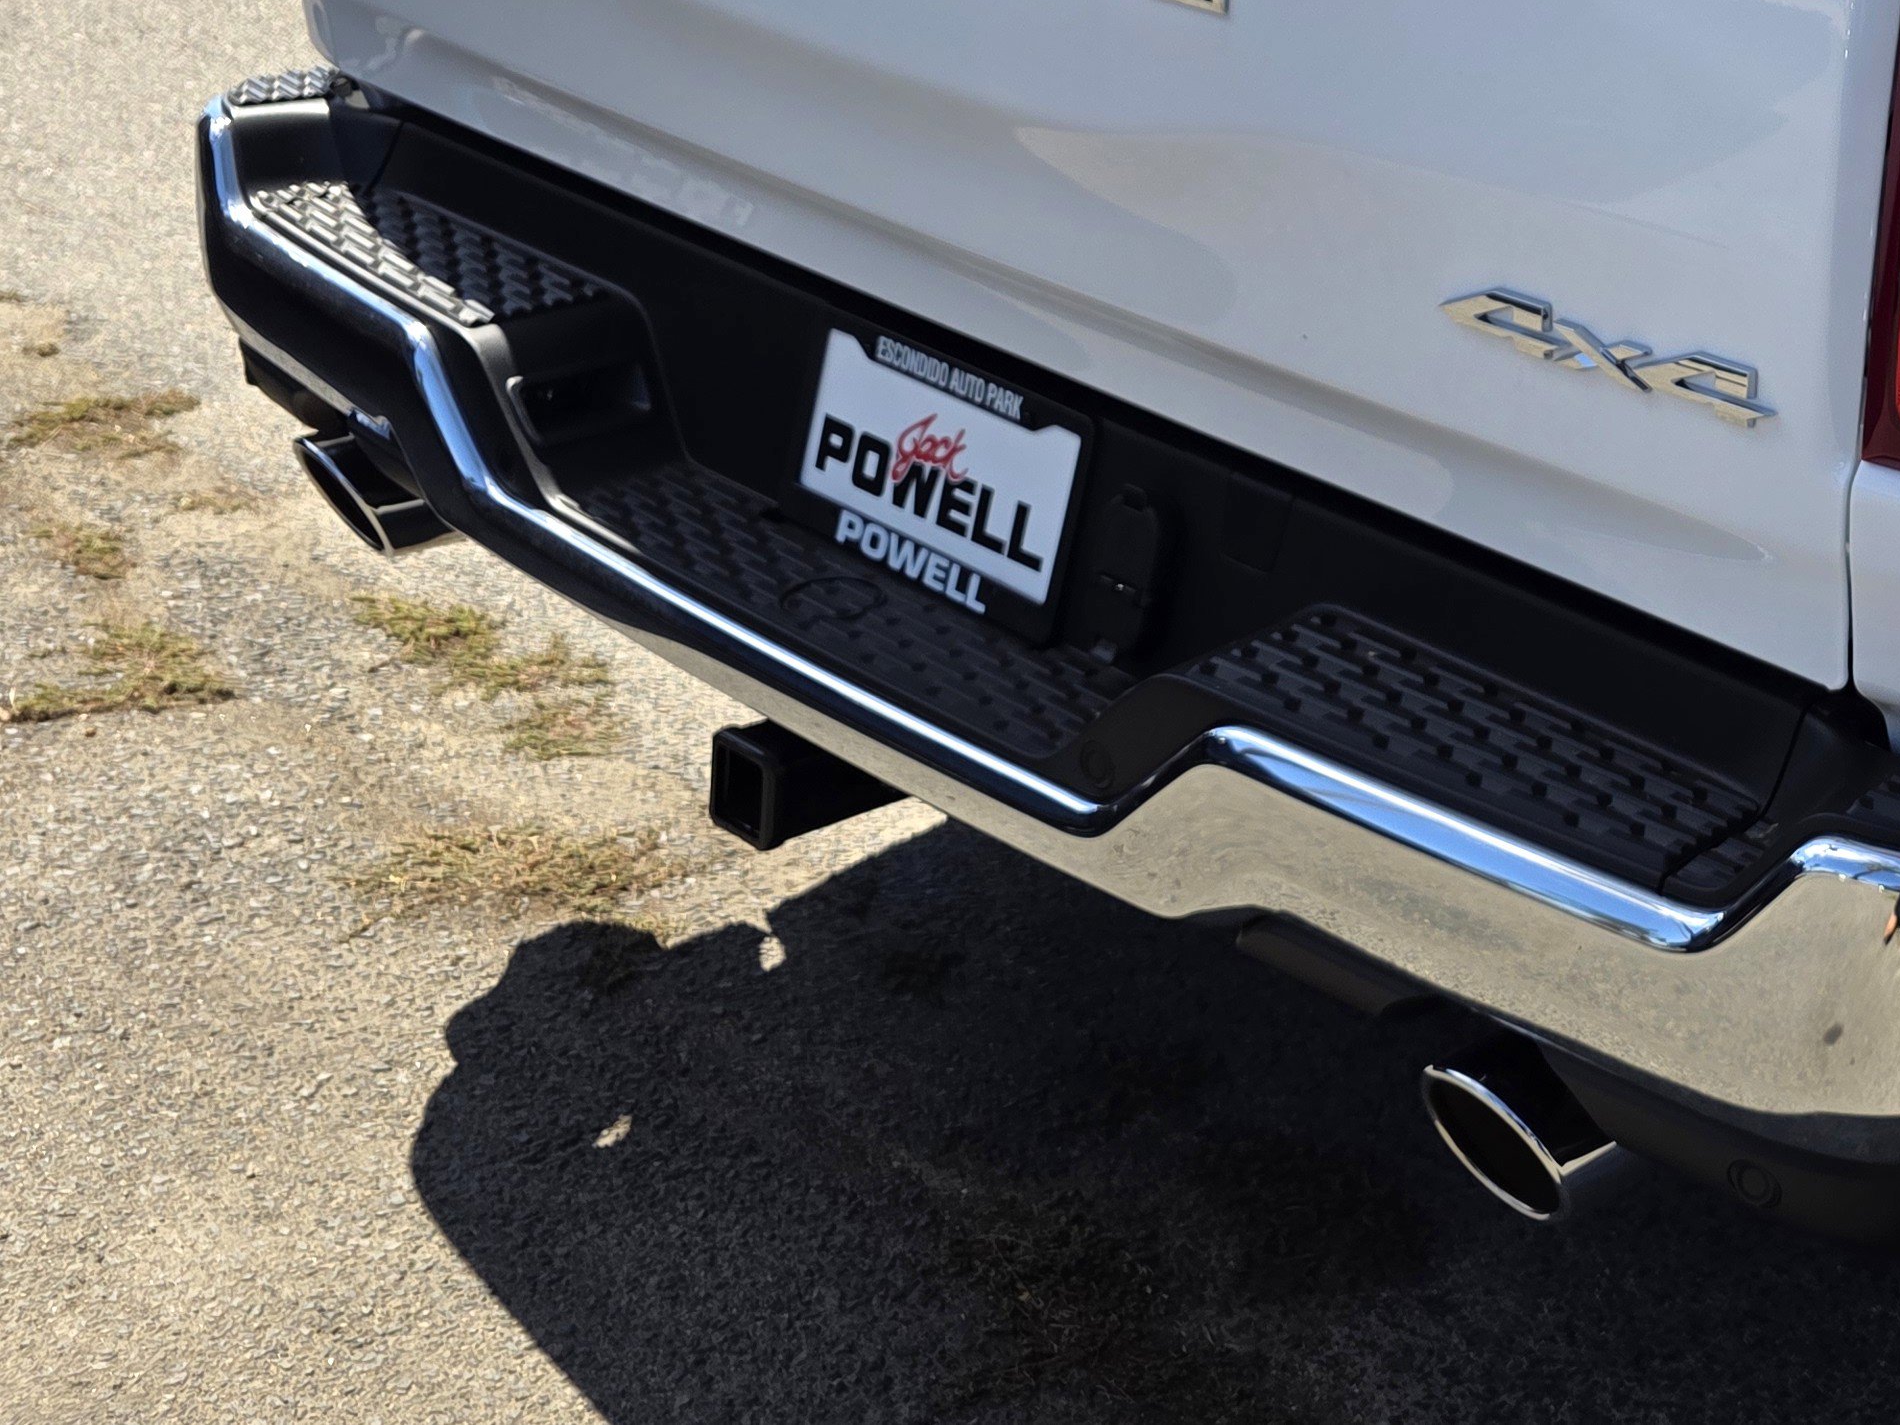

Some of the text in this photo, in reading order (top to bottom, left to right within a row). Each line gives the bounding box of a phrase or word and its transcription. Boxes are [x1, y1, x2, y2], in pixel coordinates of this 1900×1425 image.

[875, 335, 1024, 420] ESCONDIDO AUTO PARK
[815, 413, 1044, 573] POWELL
[891, 413, 969, 483] Jack
[835, 509, 986, 614] POWELL
